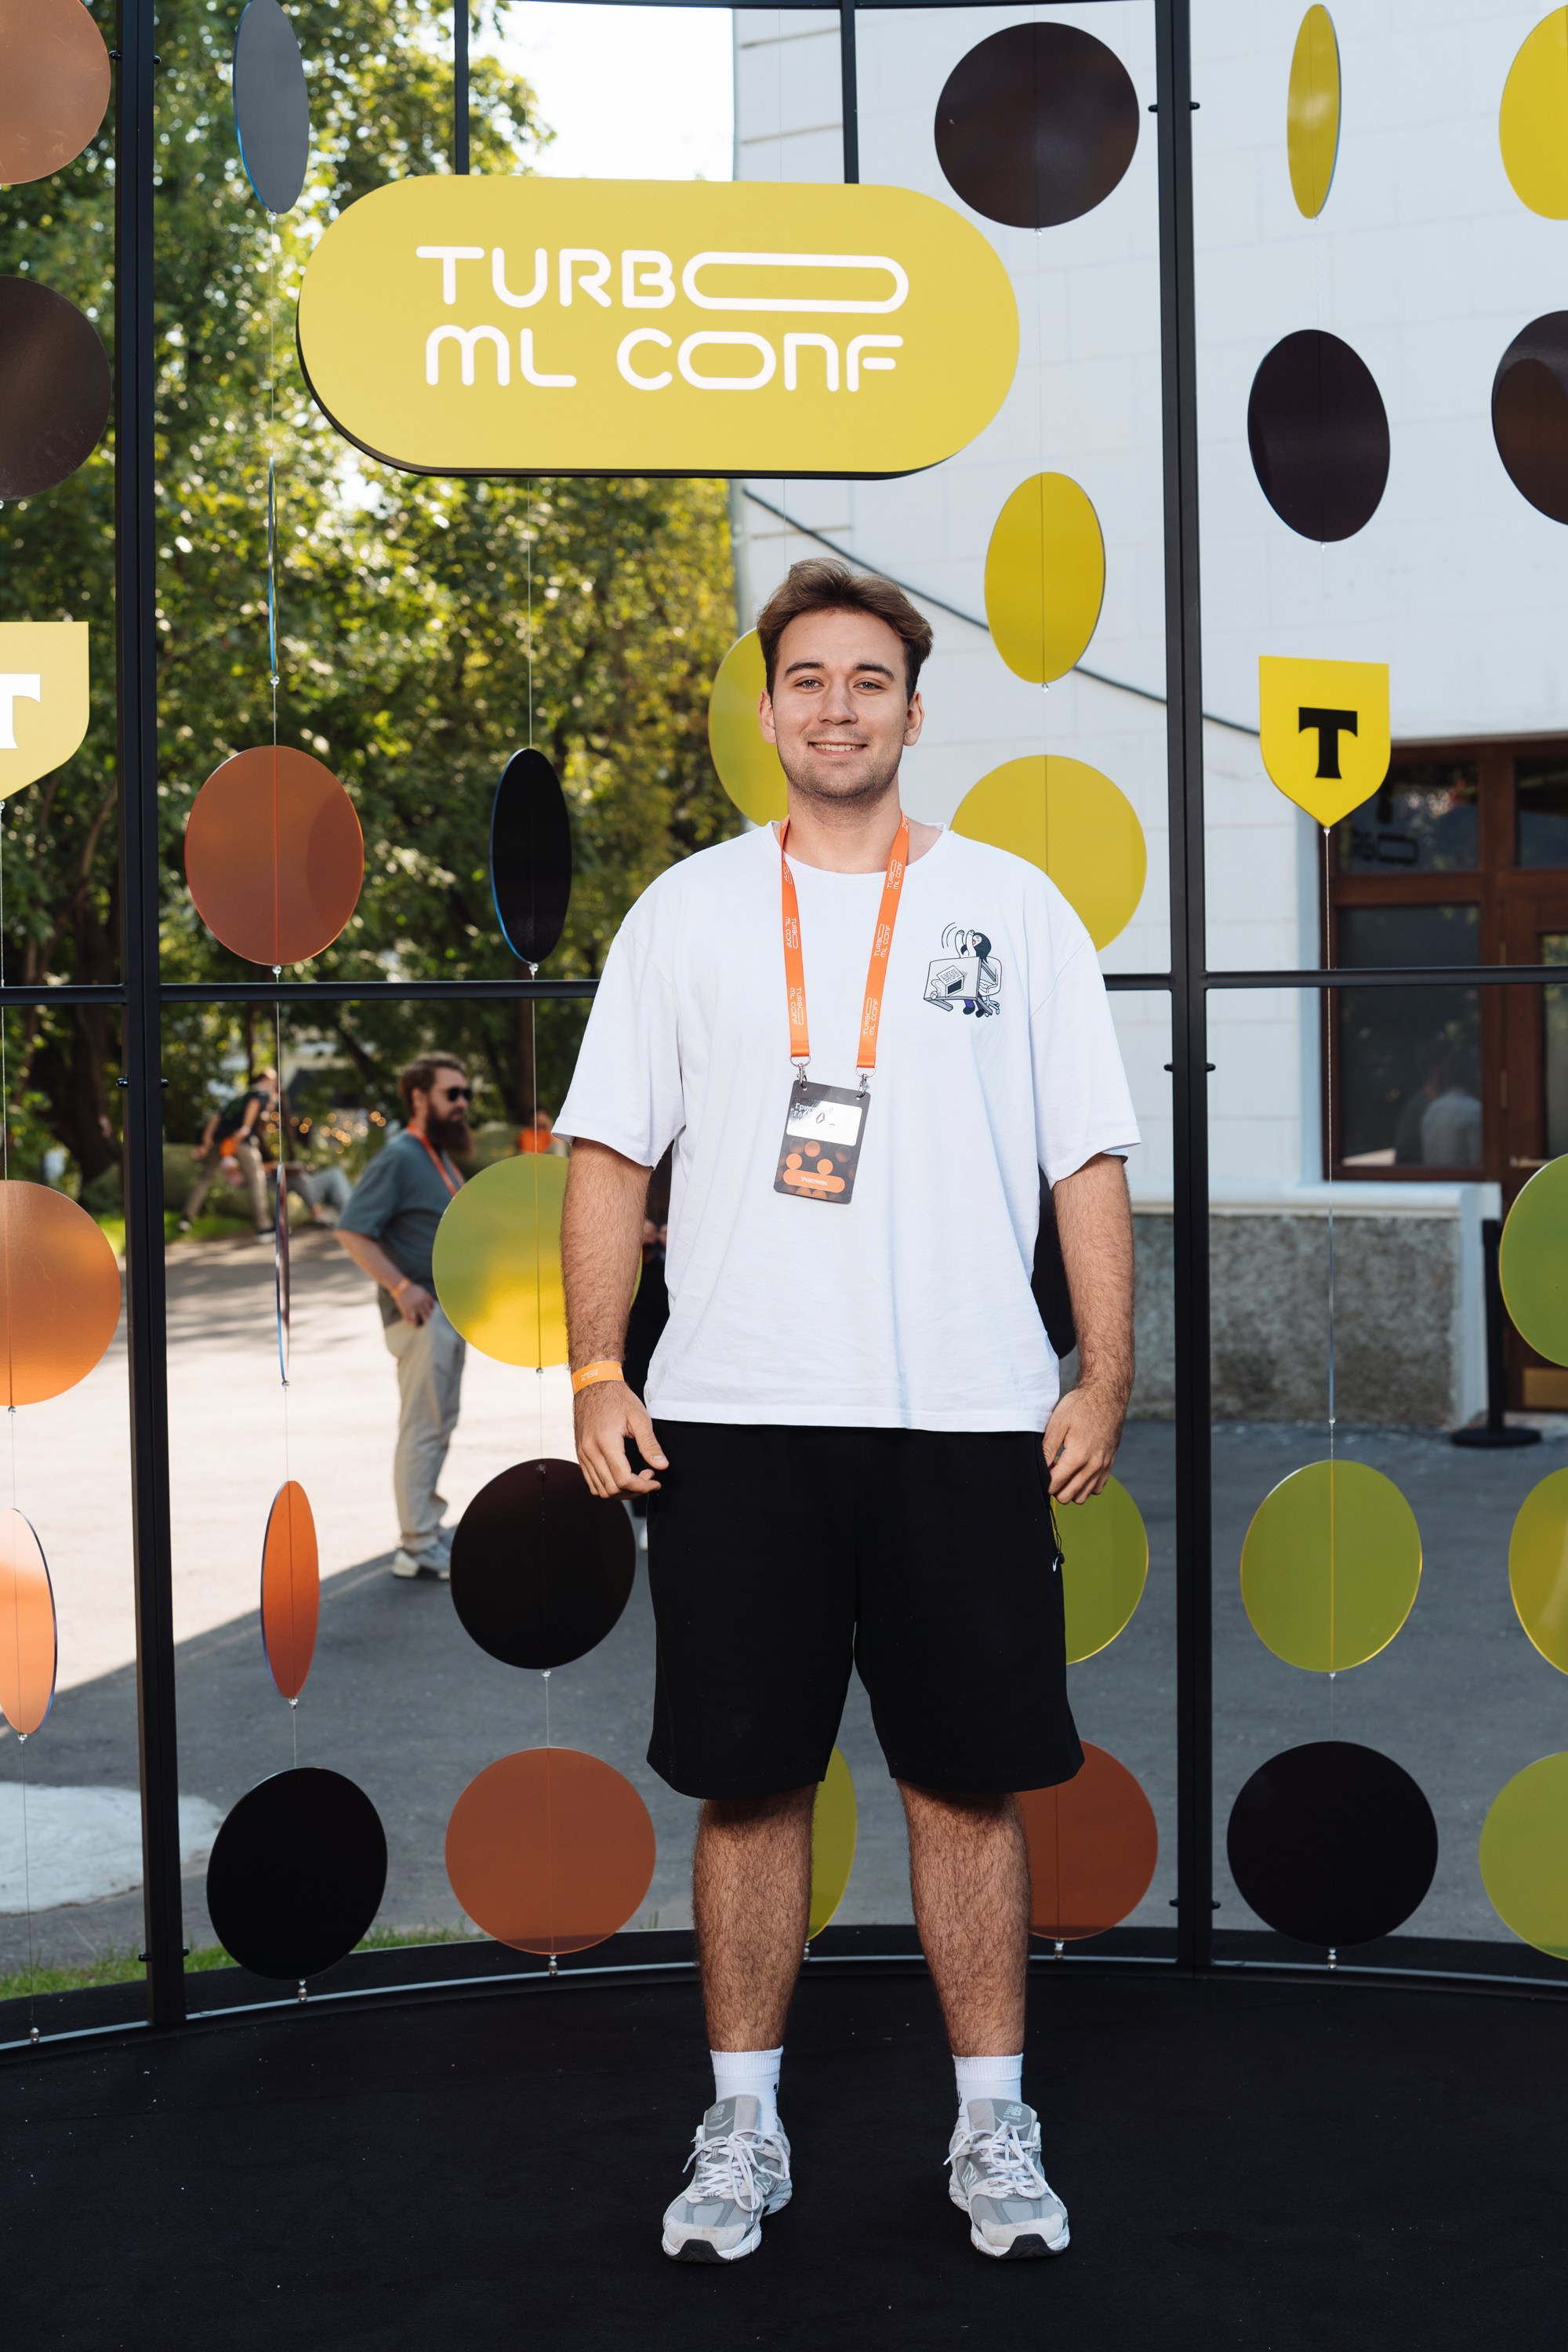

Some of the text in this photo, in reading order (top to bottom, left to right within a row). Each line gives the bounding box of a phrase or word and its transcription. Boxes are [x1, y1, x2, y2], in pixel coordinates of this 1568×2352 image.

[416, 246, 909, 314] TURBO
[426, 325, 904, 392] ML CONF
[1298, 706, 1358, 779] T
[887, 859, 897, 888] TURBO
[893, 880, 900, 890] ML
[785, 916, 790, 927] ML
[874, 924, 884, 956] TURBO
[880, 946, 887, 957] ML
[789, 987, 795, 1000] ML
[863, 997, 873, 1036] TURBO
[869, 1023, 876, 1036] ML
